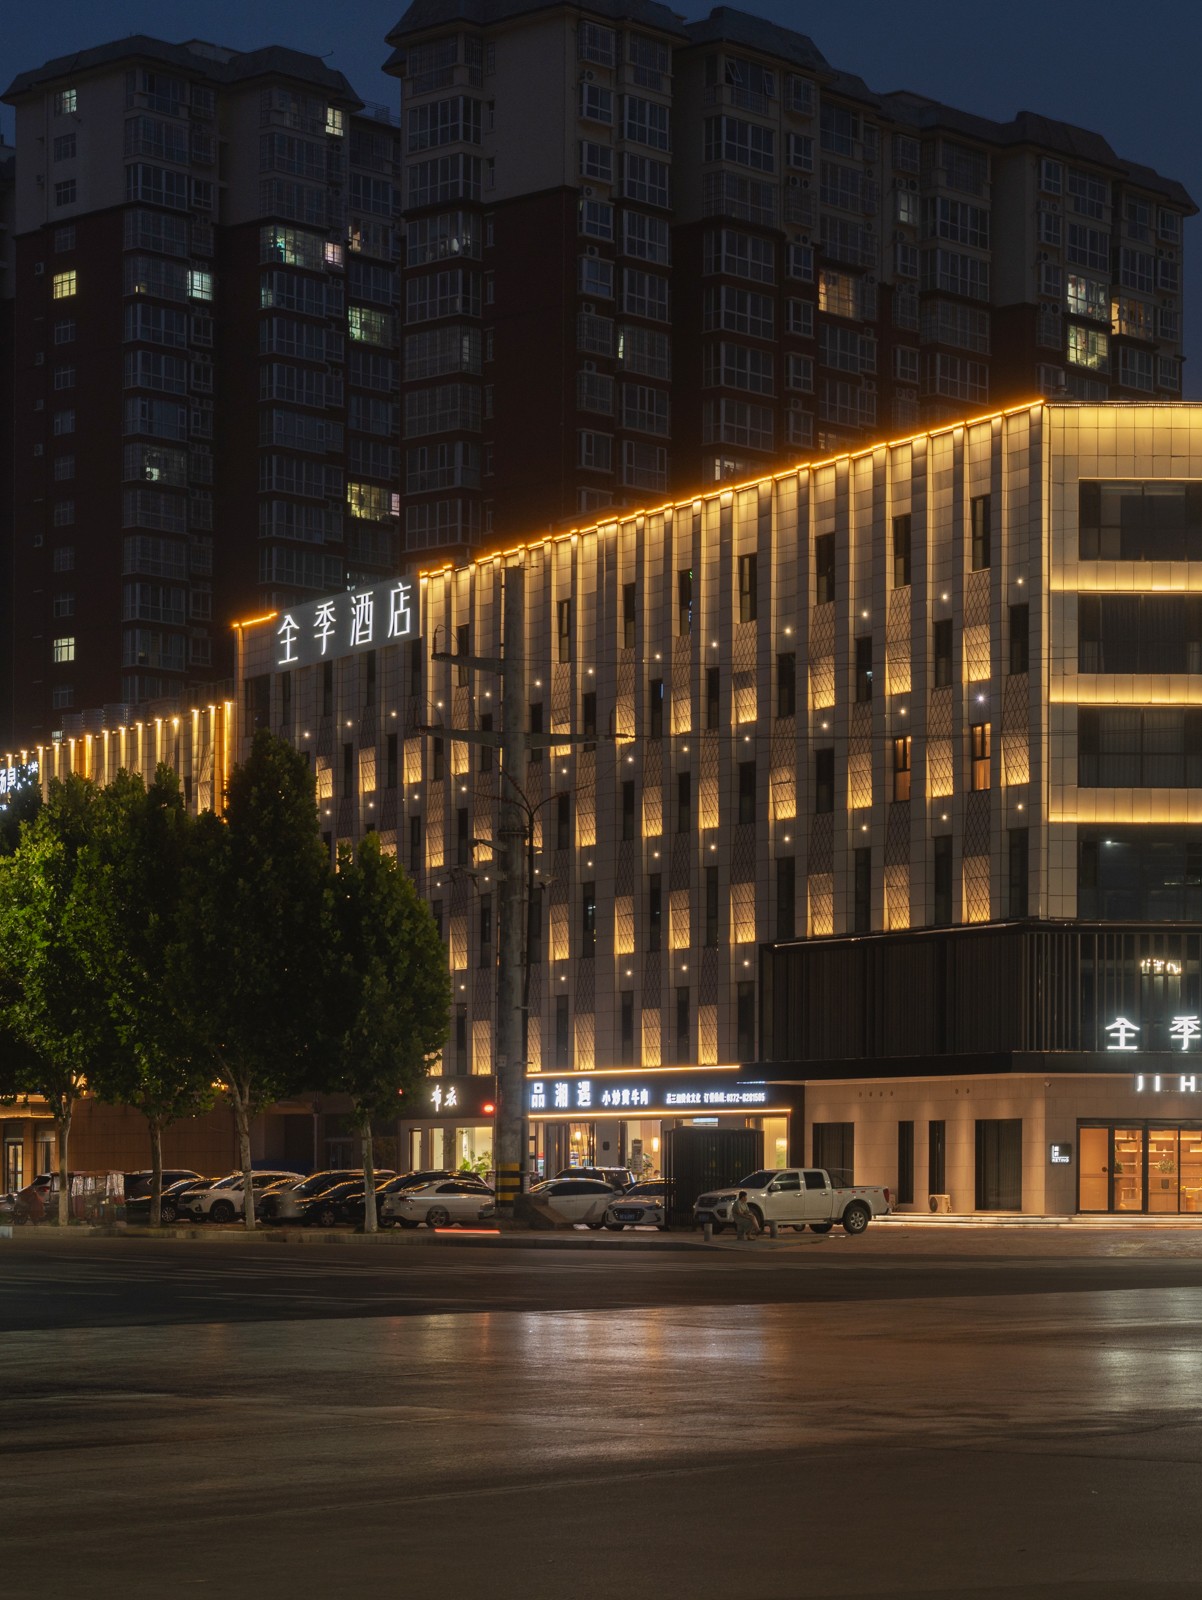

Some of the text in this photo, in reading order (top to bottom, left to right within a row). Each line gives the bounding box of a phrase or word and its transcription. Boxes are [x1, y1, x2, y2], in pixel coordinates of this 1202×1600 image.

[277, 582, 412, 665] 全季酒店
[1136, 1073, 1162, 1093] JI
